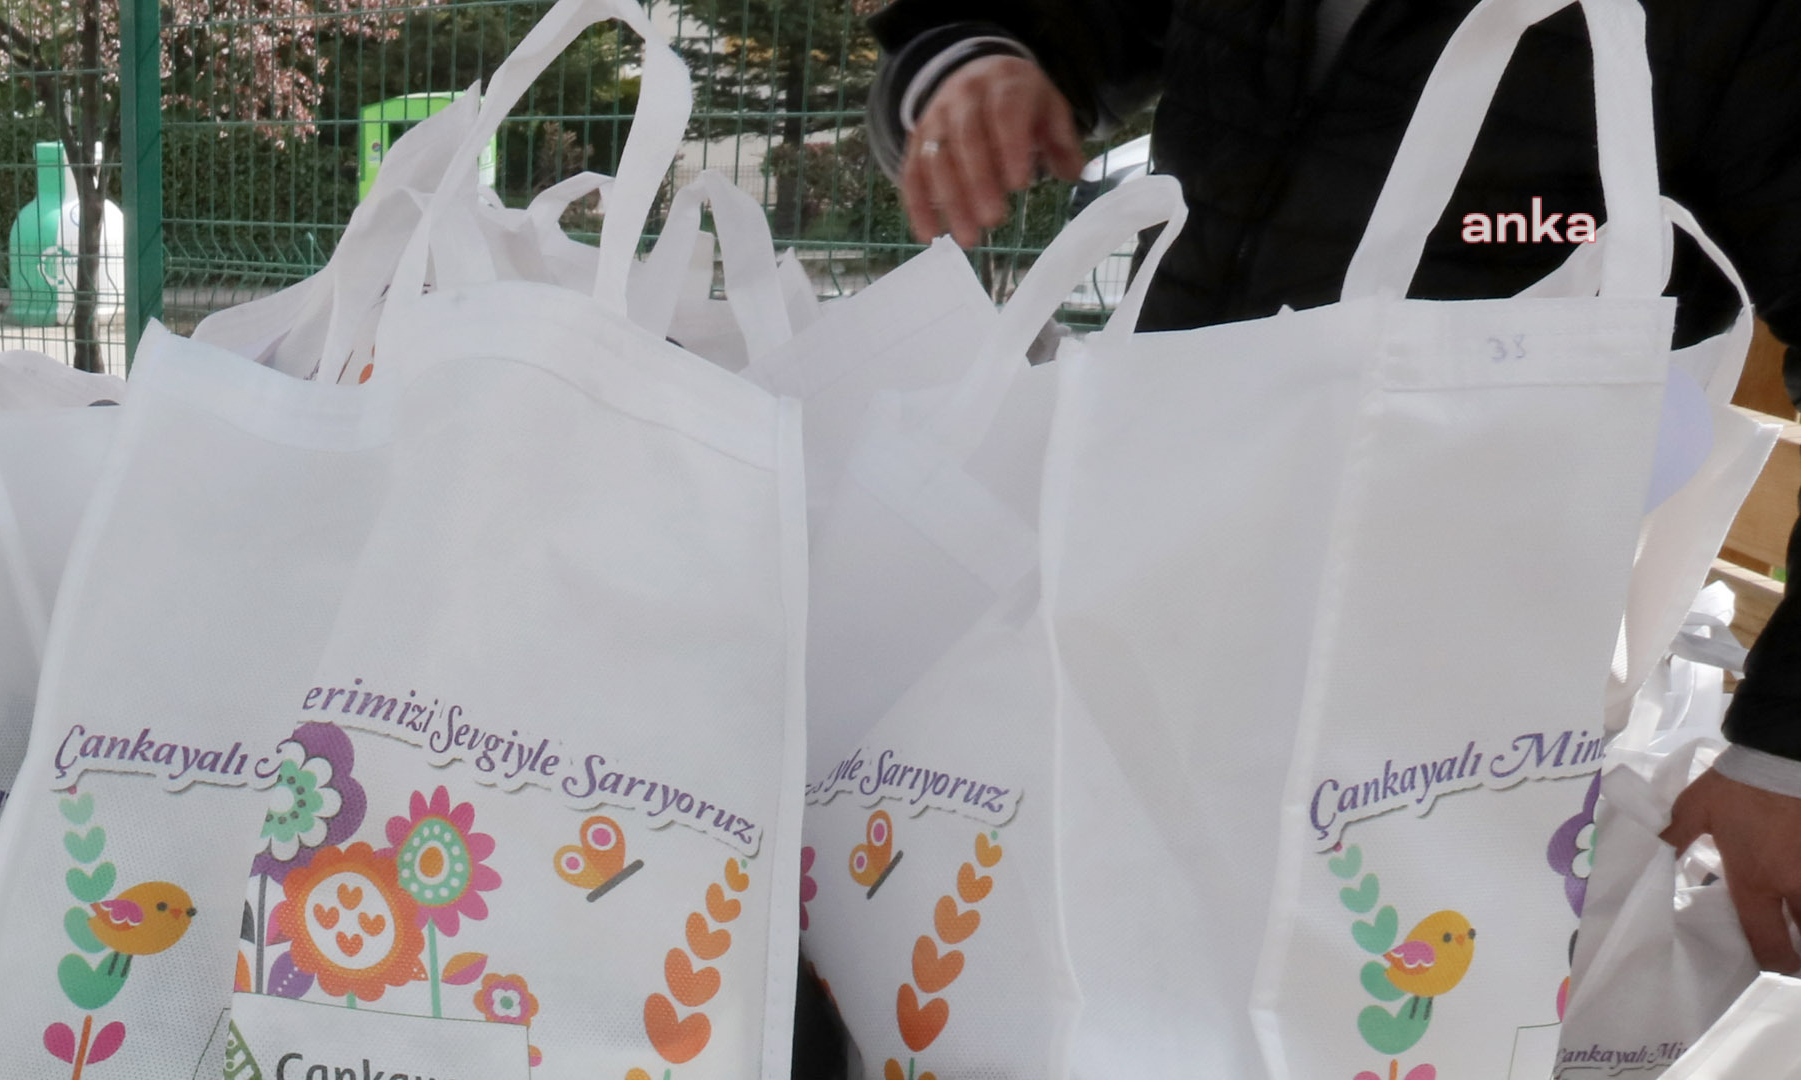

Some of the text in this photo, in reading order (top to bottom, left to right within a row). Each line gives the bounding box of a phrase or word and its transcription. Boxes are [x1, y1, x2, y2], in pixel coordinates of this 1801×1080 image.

[54, 725, 248, 780] Çankayalı
[429, 705, 560, 778] Sevgiyle
[562, 754, 756, 844] Sarıyoruz
[859, 750, 1010, 813] Sarıyoruz
[1309, 741, 1483, 840] Çankayalı
